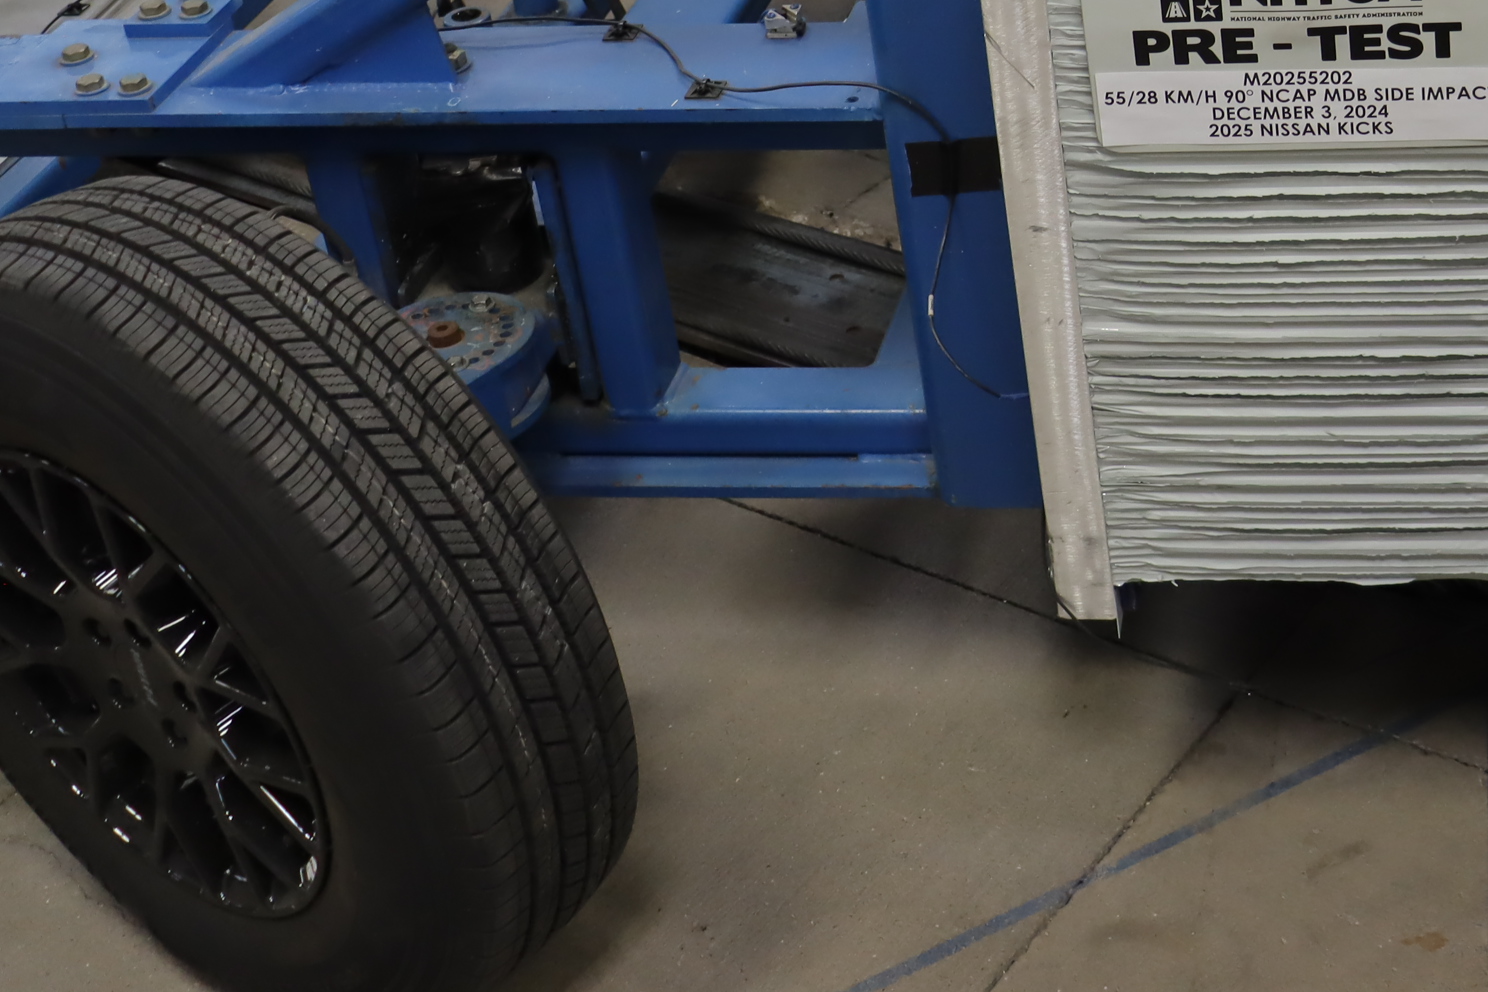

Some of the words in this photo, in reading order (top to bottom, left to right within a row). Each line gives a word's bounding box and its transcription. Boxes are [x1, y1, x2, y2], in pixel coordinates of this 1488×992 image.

[1334, 12, 1360, 20] SAFETY
[1361, 11, 1424, 19] ADMINISTRATION
[1132, 27, 1259, 66] PRE
[1306, 22, 1462, 61] TEST
[1243, 70, 1353, 86] M20255202
[1104, 90, 1158, 107] 55/28
[1165, 89, 1217, 106] KM/H
[1223, 89, 1254, 104] 90°
[1261, 88, 1317, 103] NCAP
[1323, 87, 1367, 102] MDB
[1374, 87, 1415, 101] SIDE
[1212, 105, 1314, 121] DECEMBER
[1321, 105, 1338, 121] 3,
[1343, 104, 1389, 119] 2024
[1209, 123, 1254, 138] 2025
[1260, 122, 1331, 137] NISSAN
[1338, 121, 1394, 136] KICKS
